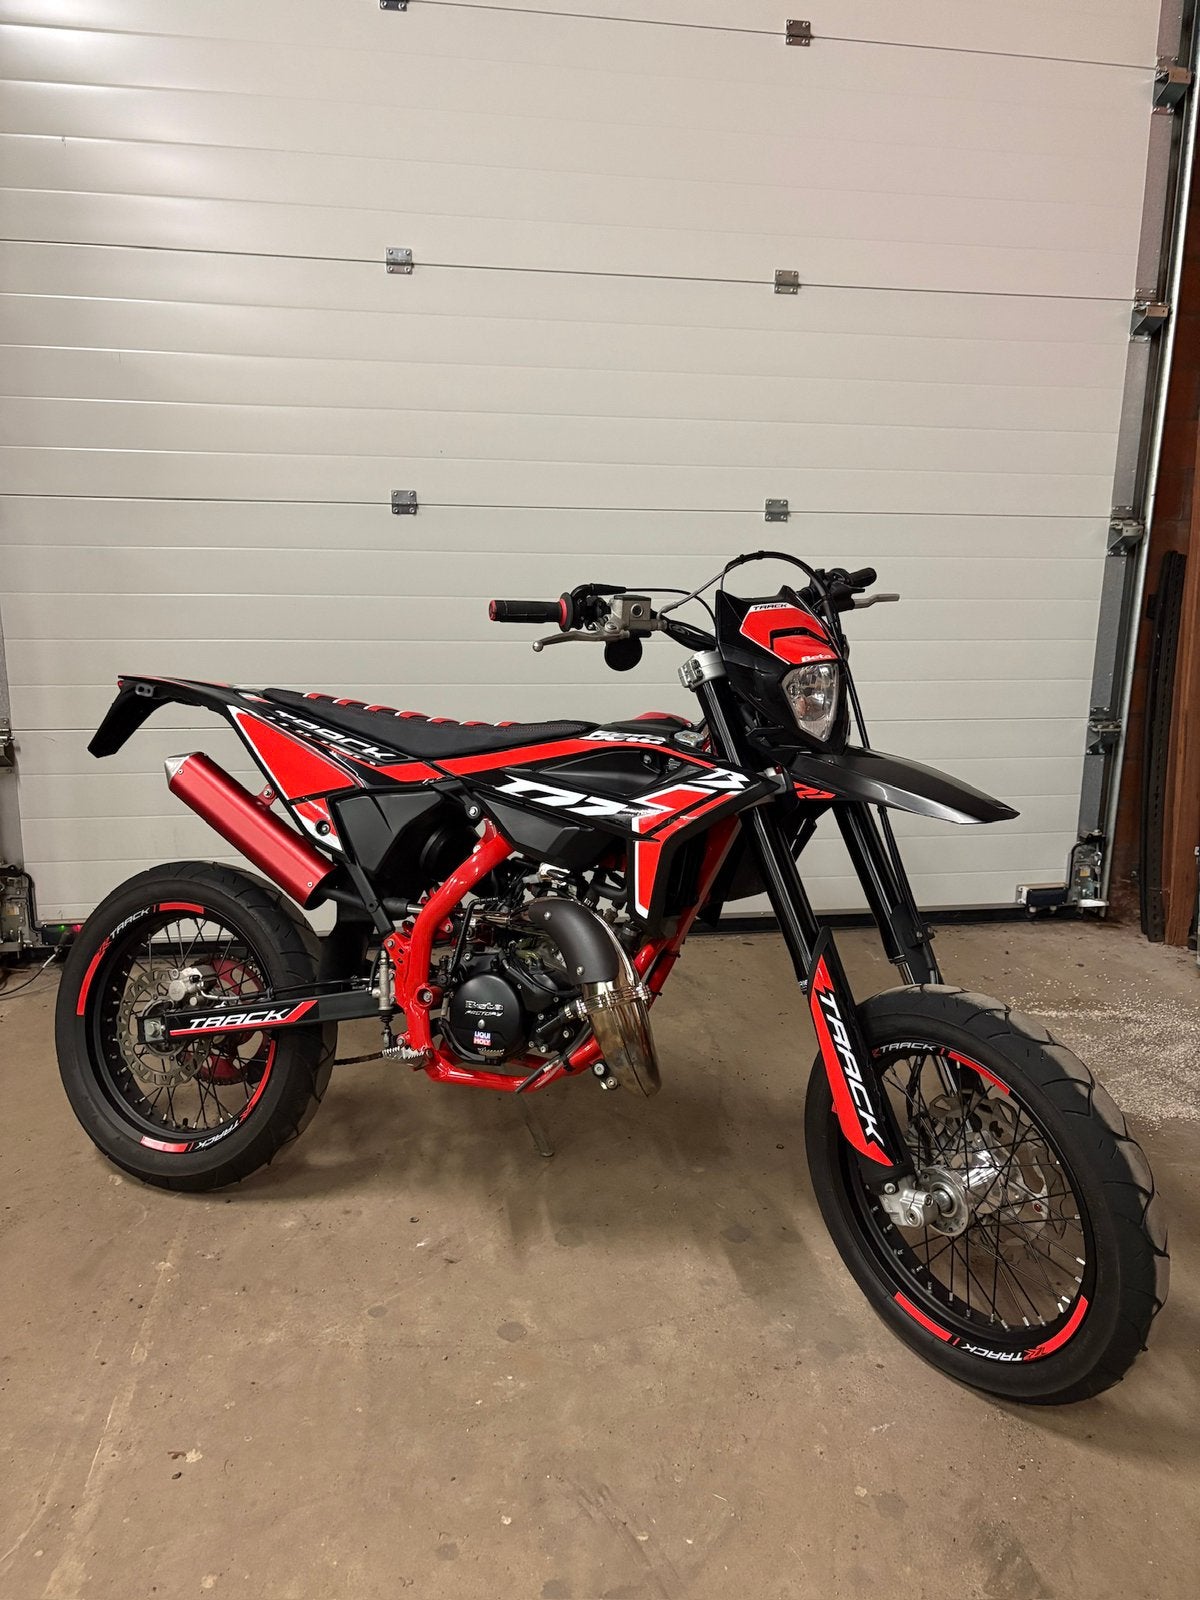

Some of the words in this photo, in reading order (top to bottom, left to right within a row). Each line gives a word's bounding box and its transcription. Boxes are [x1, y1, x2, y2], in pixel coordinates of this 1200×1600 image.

[754, 603, 788, 611] TRACK
[801, 653, 833, 663] Beta
[110, 906, 150, 939] TRACK
[189, 1008, 290, 1029] TRACK
[881, 1042, 937, 1053] TRACK
[820, 993, 886, 1147] TRACK
[195, 1119, 239, 1149] TRACK
[961, 1343, 1022, 1361] TRACK
